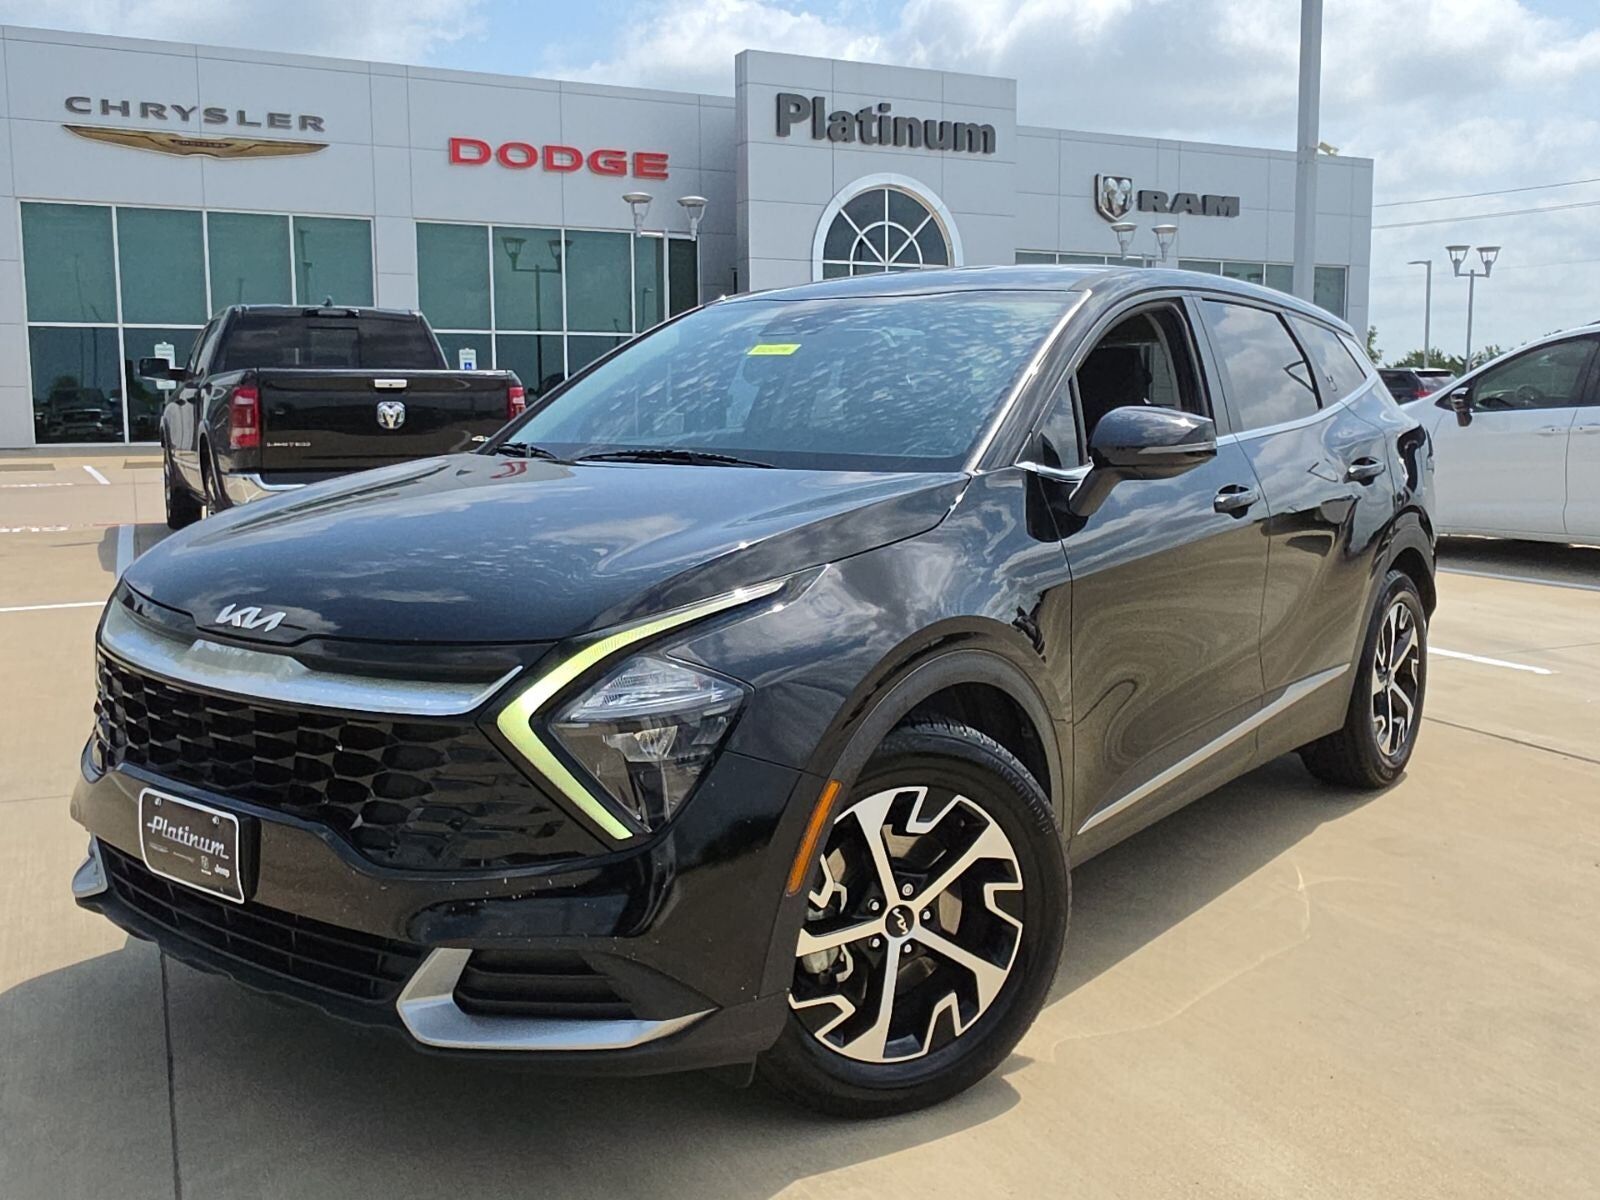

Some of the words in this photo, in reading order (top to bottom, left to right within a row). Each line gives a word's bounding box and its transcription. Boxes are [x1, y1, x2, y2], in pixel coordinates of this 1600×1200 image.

[64, 96, 326, 132] CHRYSLER
[776, 92, 996, 154] Platinum
[449, 137, 669, 180] DODGE
[1138, 189, 1241, 217] RAM
[147, 816, 229, 859] Platinum
